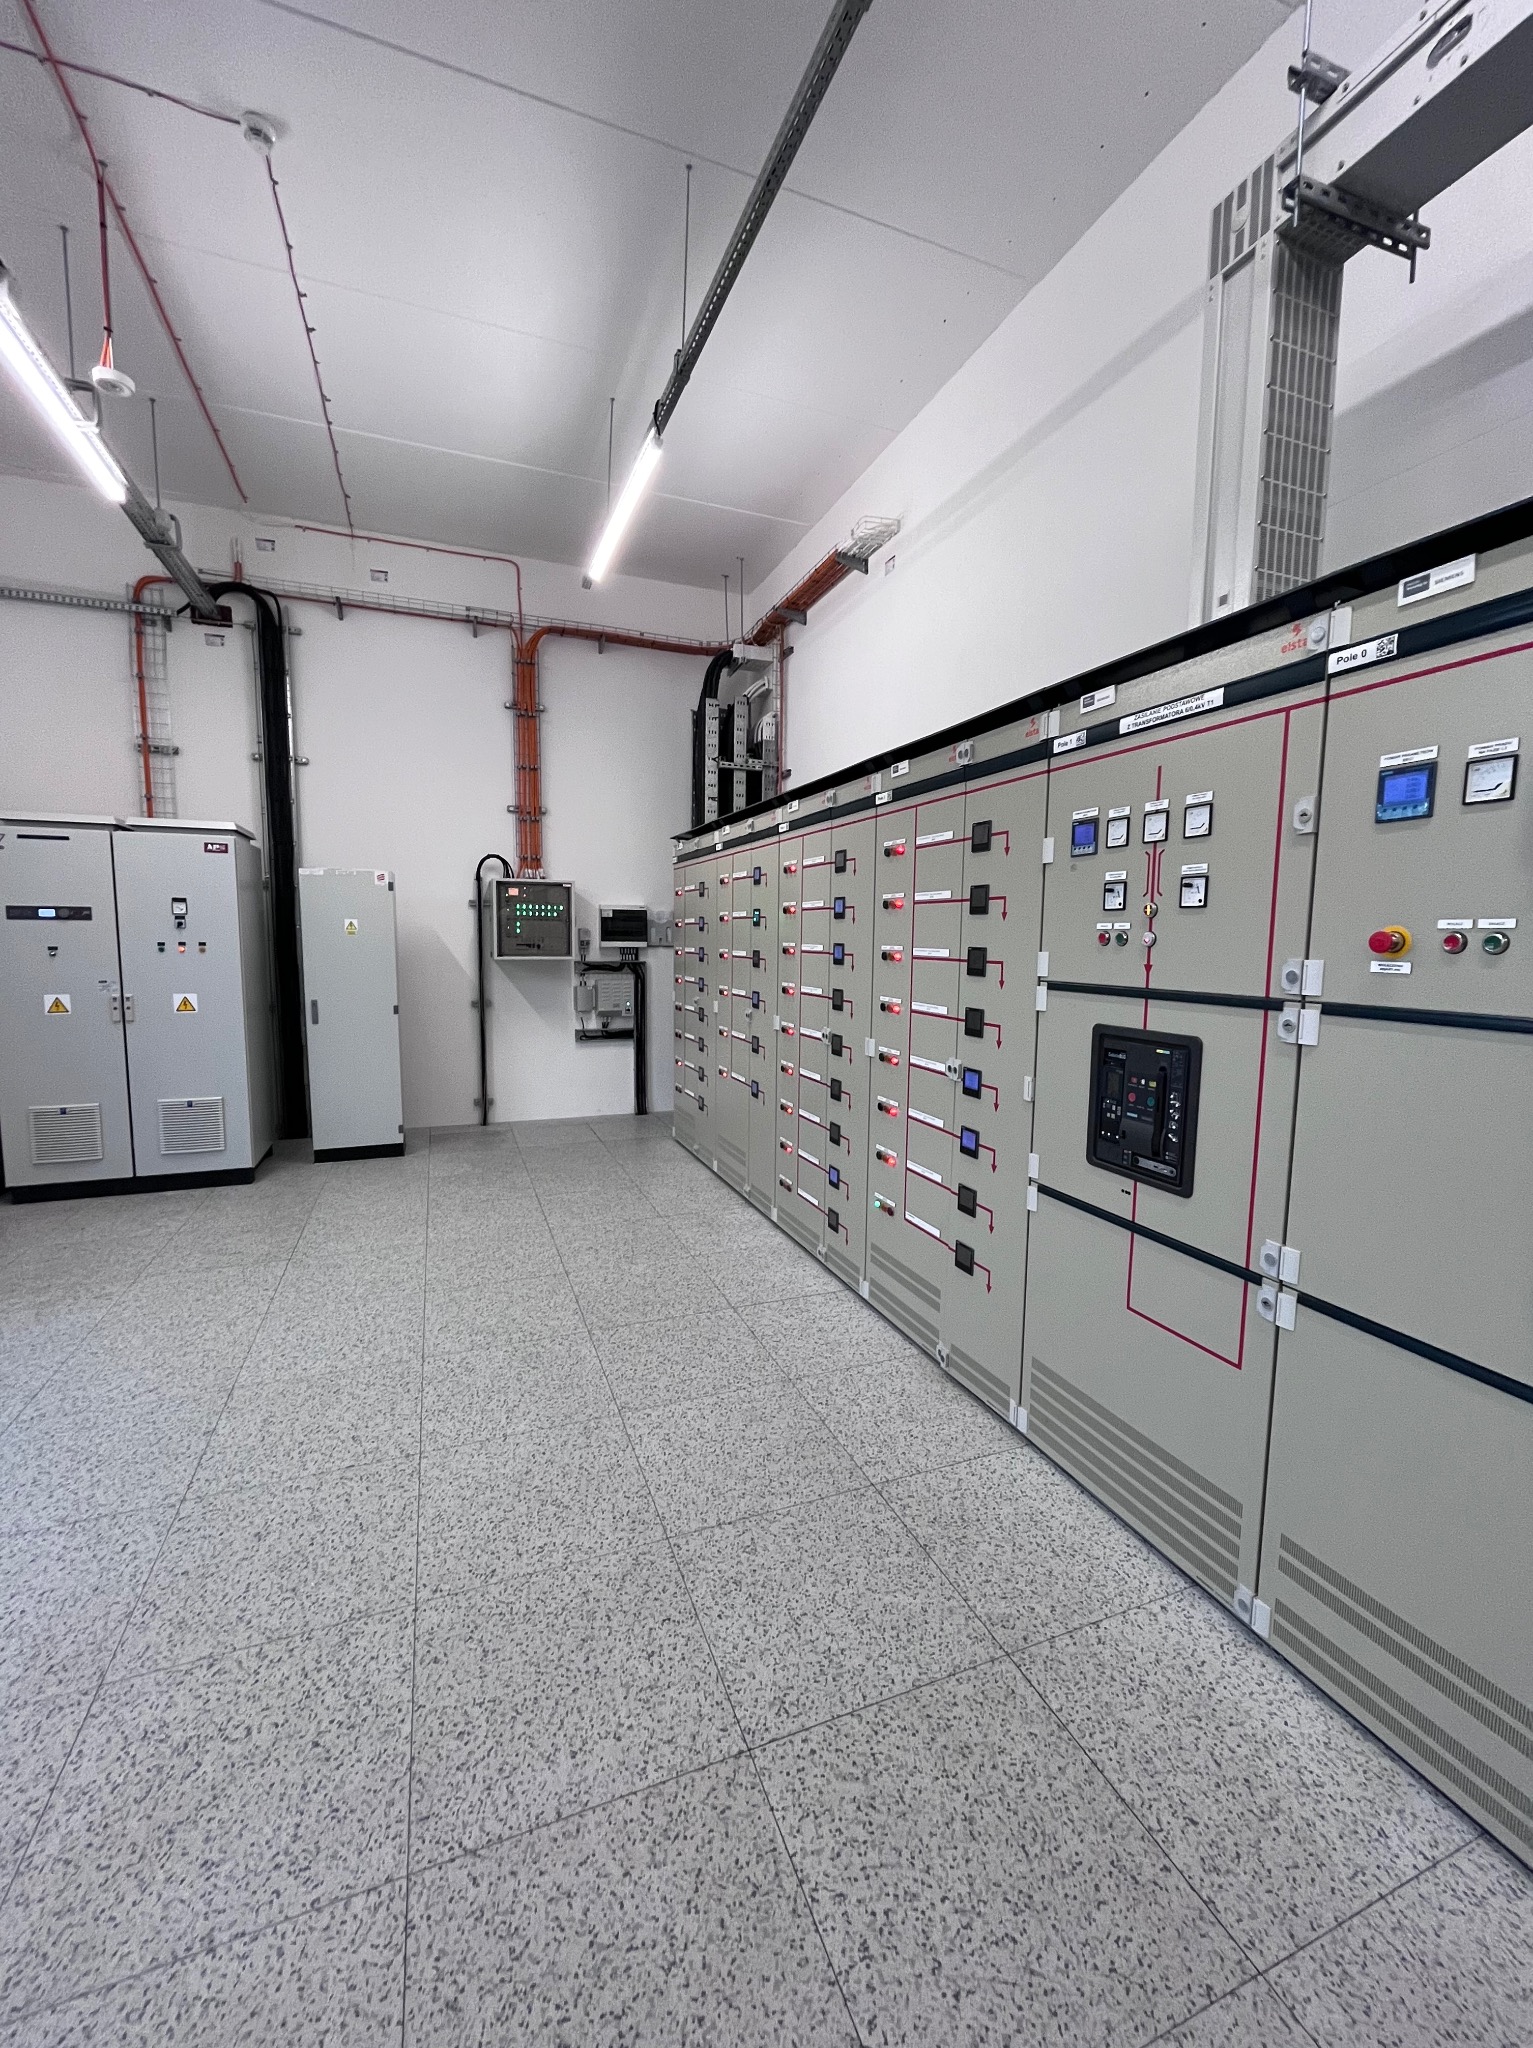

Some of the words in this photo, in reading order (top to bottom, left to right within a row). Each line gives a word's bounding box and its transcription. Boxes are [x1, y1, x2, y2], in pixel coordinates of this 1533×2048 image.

[1336, 652, 1358, 665] Pole
[1361, 649, 1367, 658] 0
[1134, 707, 1161, 721] ZASILANIE
[1162, 693, 1205, 713] PODSTAWOWE
[1131, 708, 1184, 728] TRANSFORMATORA
[1057, 740, 1068, 748] Pole
